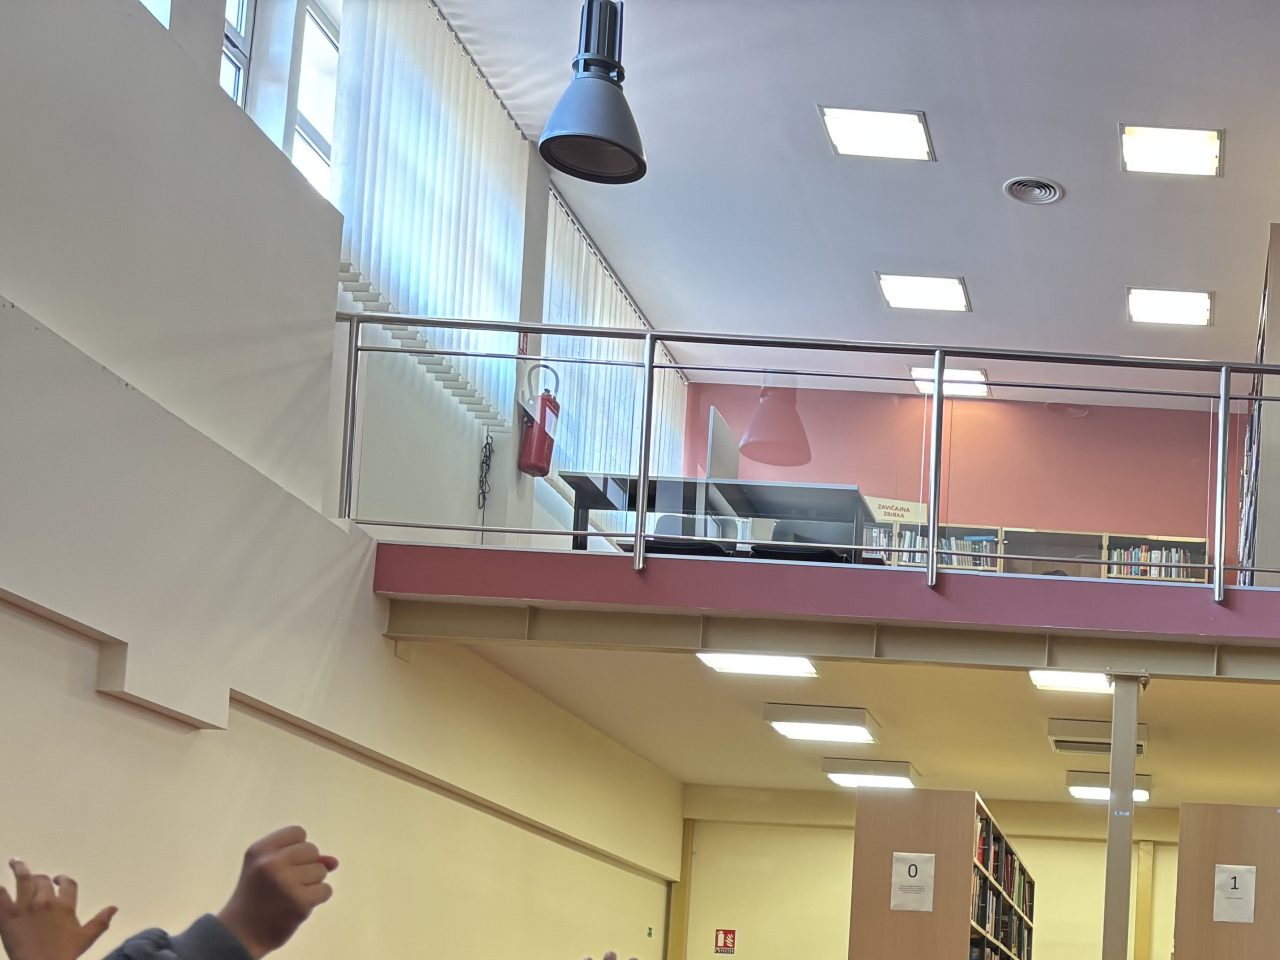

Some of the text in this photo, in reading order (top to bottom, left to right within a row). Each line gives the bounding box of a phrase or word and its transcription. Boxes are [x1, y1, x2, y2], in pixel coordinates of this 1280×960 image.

[878, 503, 911, 513] ZAVIČAJNA
[883, 511, 905, 519] ZBIRKA
[908, 863, 918, 878] 0
[1230, 876, 1239, 890] 1
